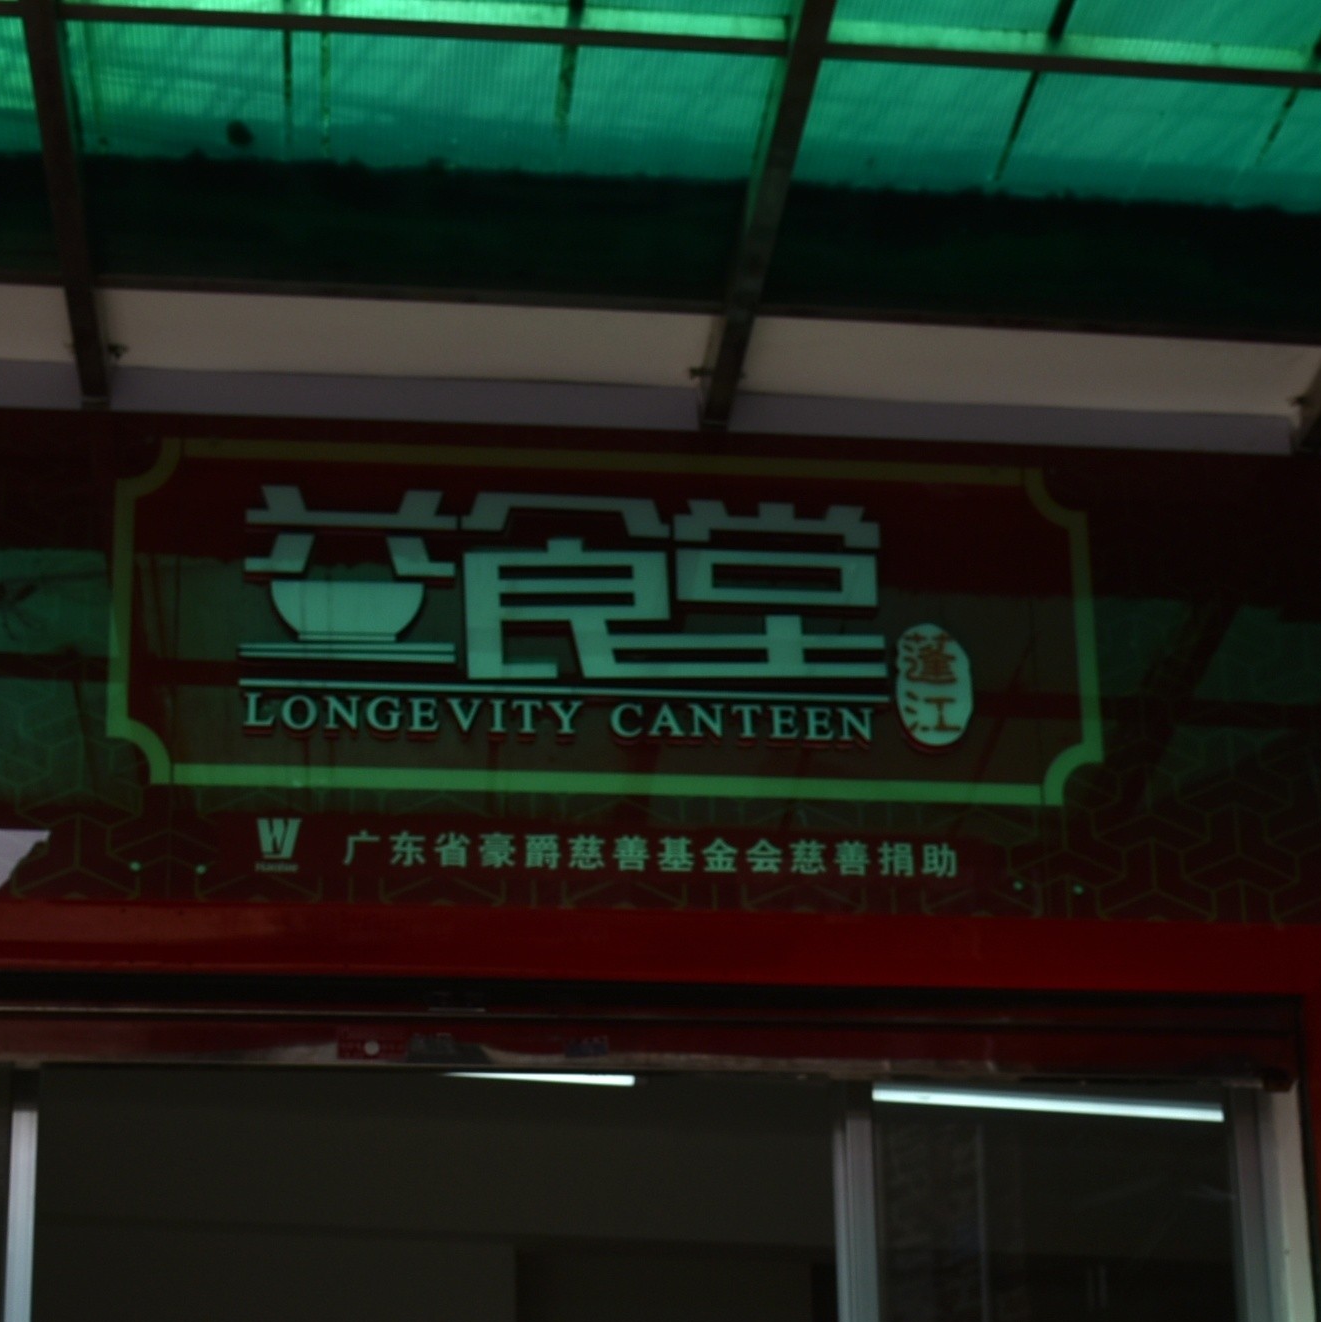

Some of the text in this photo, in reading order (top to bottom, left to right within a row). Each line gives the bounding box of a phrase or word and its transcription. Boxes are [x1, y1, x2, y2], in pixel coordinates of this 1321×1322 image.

[901, 629, 965, 735] 蓬江
[242, 691, 874, 743] LONGEVITY CANTEEN
[342, 829, 959, 879] 广东省豪爵慈善基金会慈善捐助
